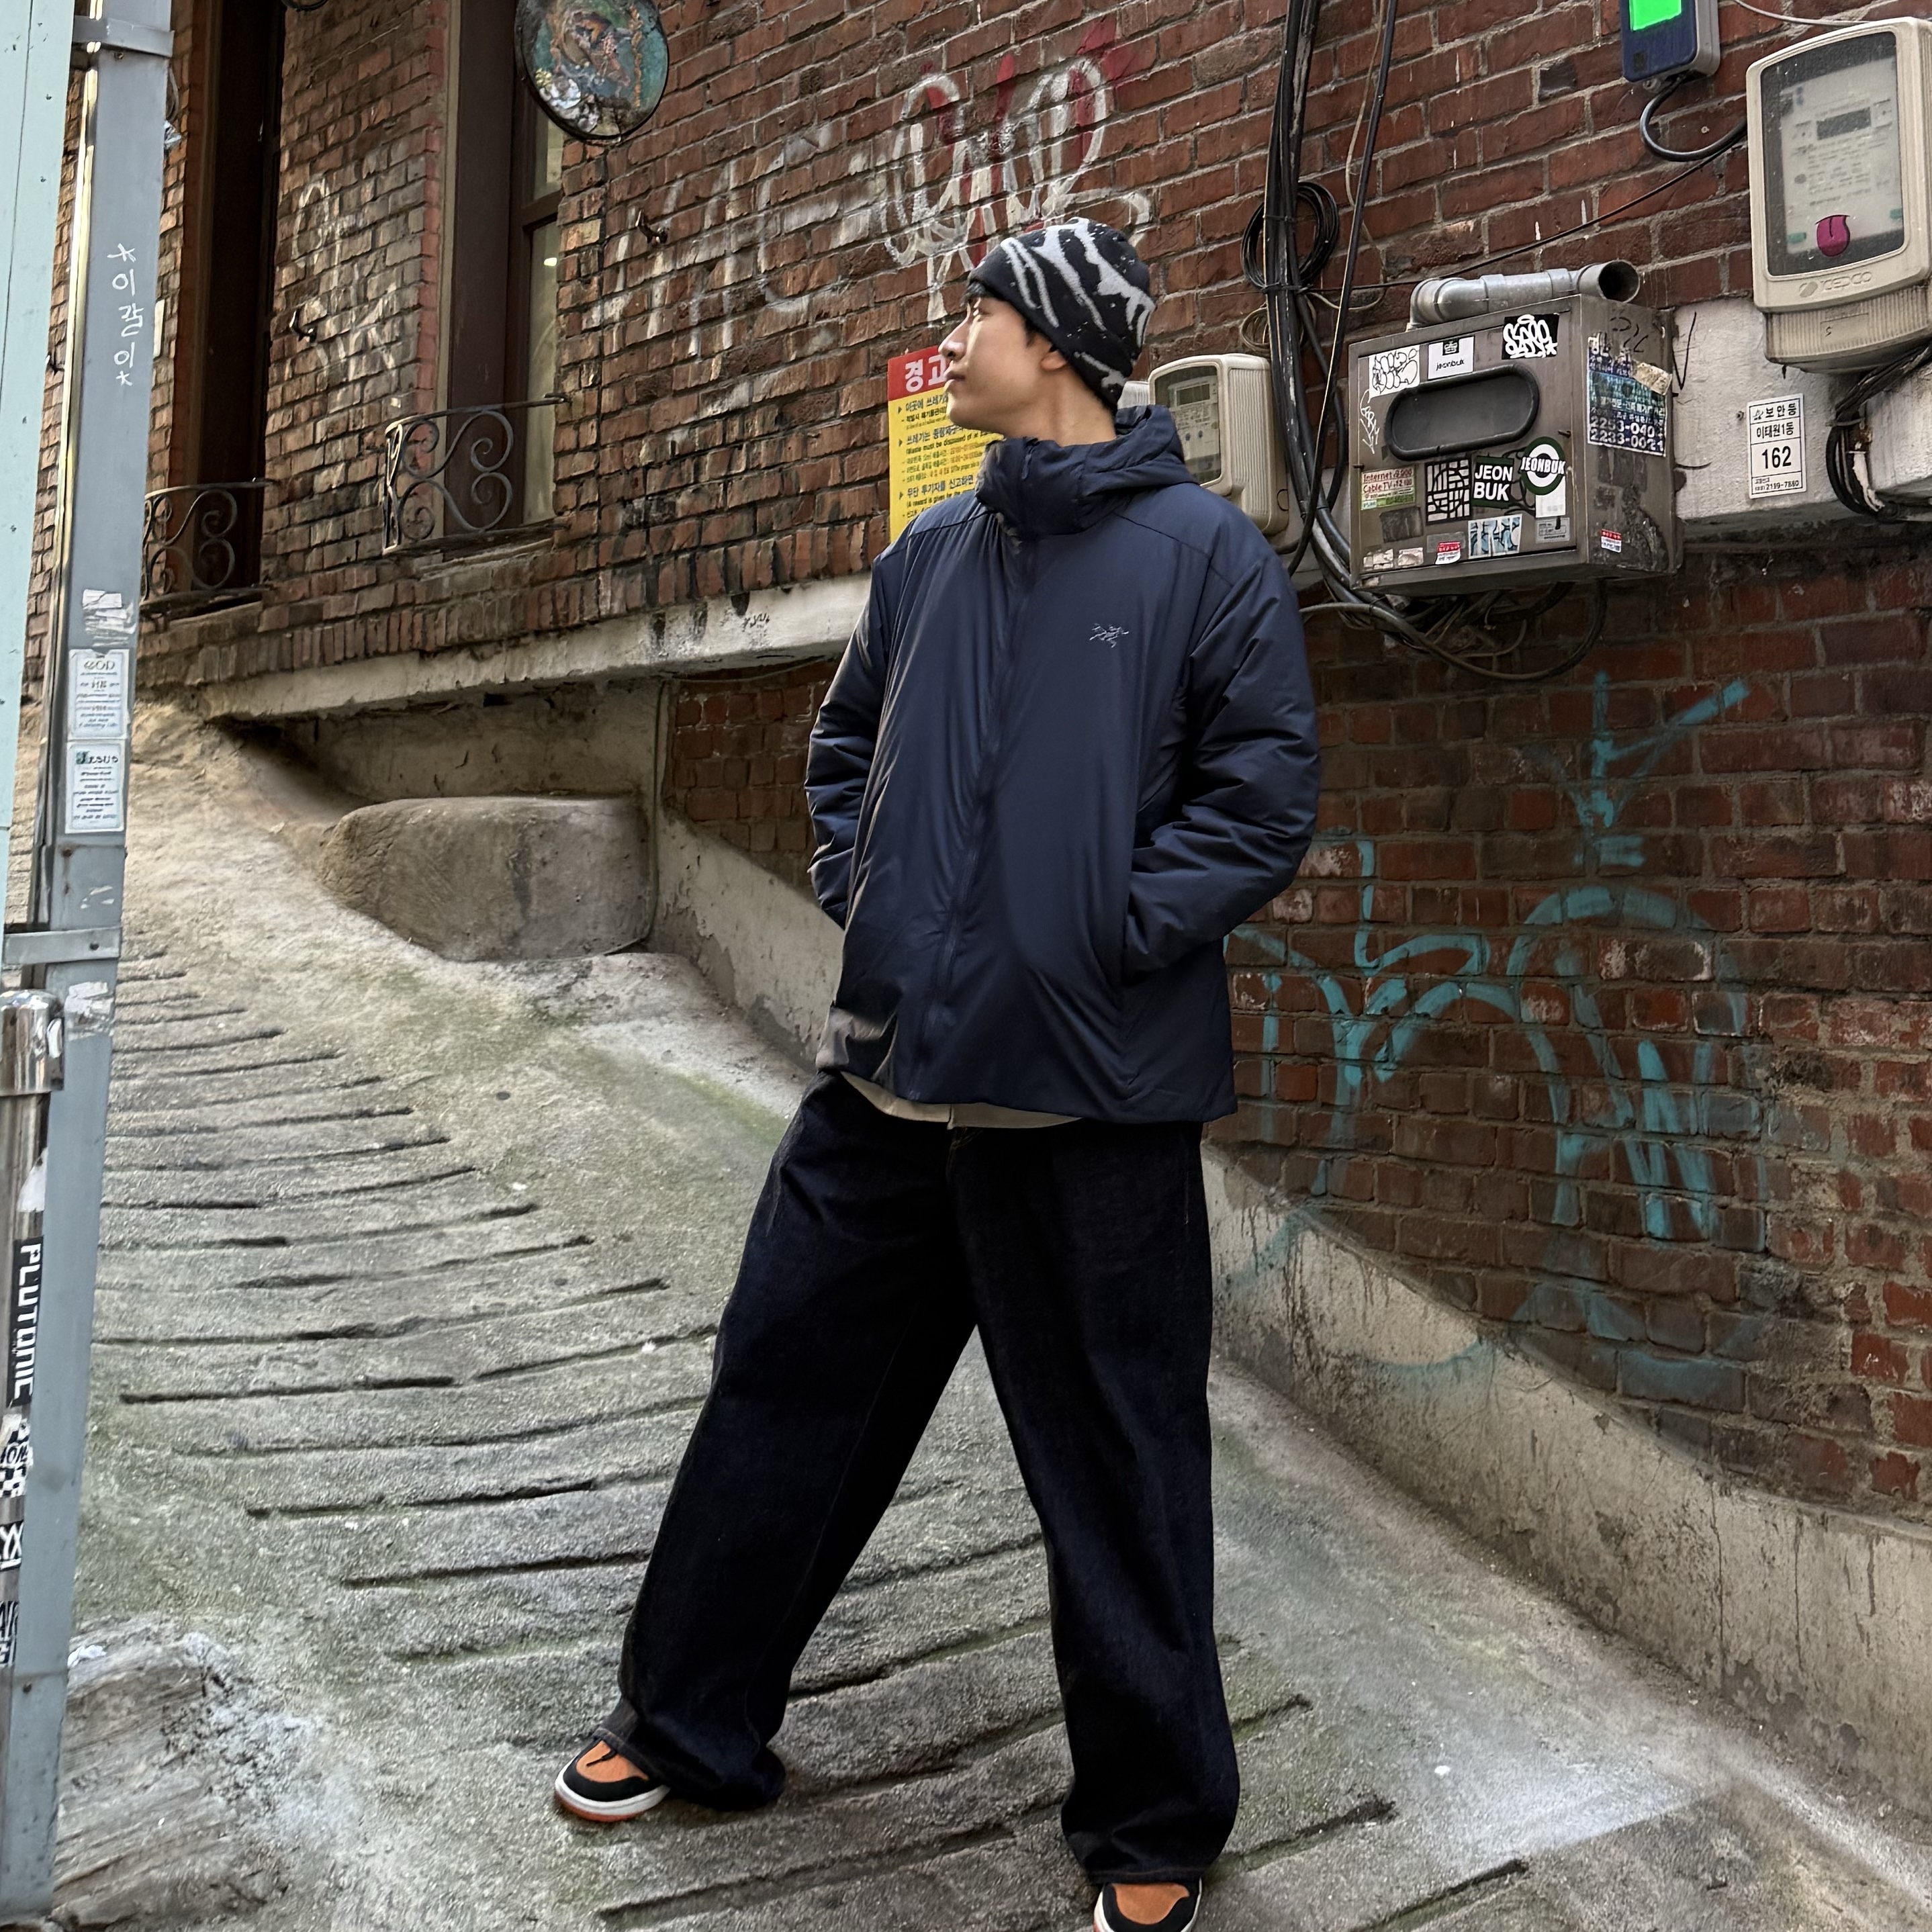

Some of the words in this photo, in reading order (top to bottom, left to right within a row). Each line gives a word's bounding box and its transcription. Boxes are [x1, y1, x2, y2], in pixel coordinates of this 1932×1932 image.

[1765, 403, 1796, 418] 보안등
[1756, 422, 1794, 439] 이태원1동
[1761, 445, 1792, 469] 162
[1474, 464, 1513, 481] JEON
[1520, 457, 1566, 475] JEONBUK
[907, 487, 919, 498] 무단
[1473, 481, 1510, 501] BUK
